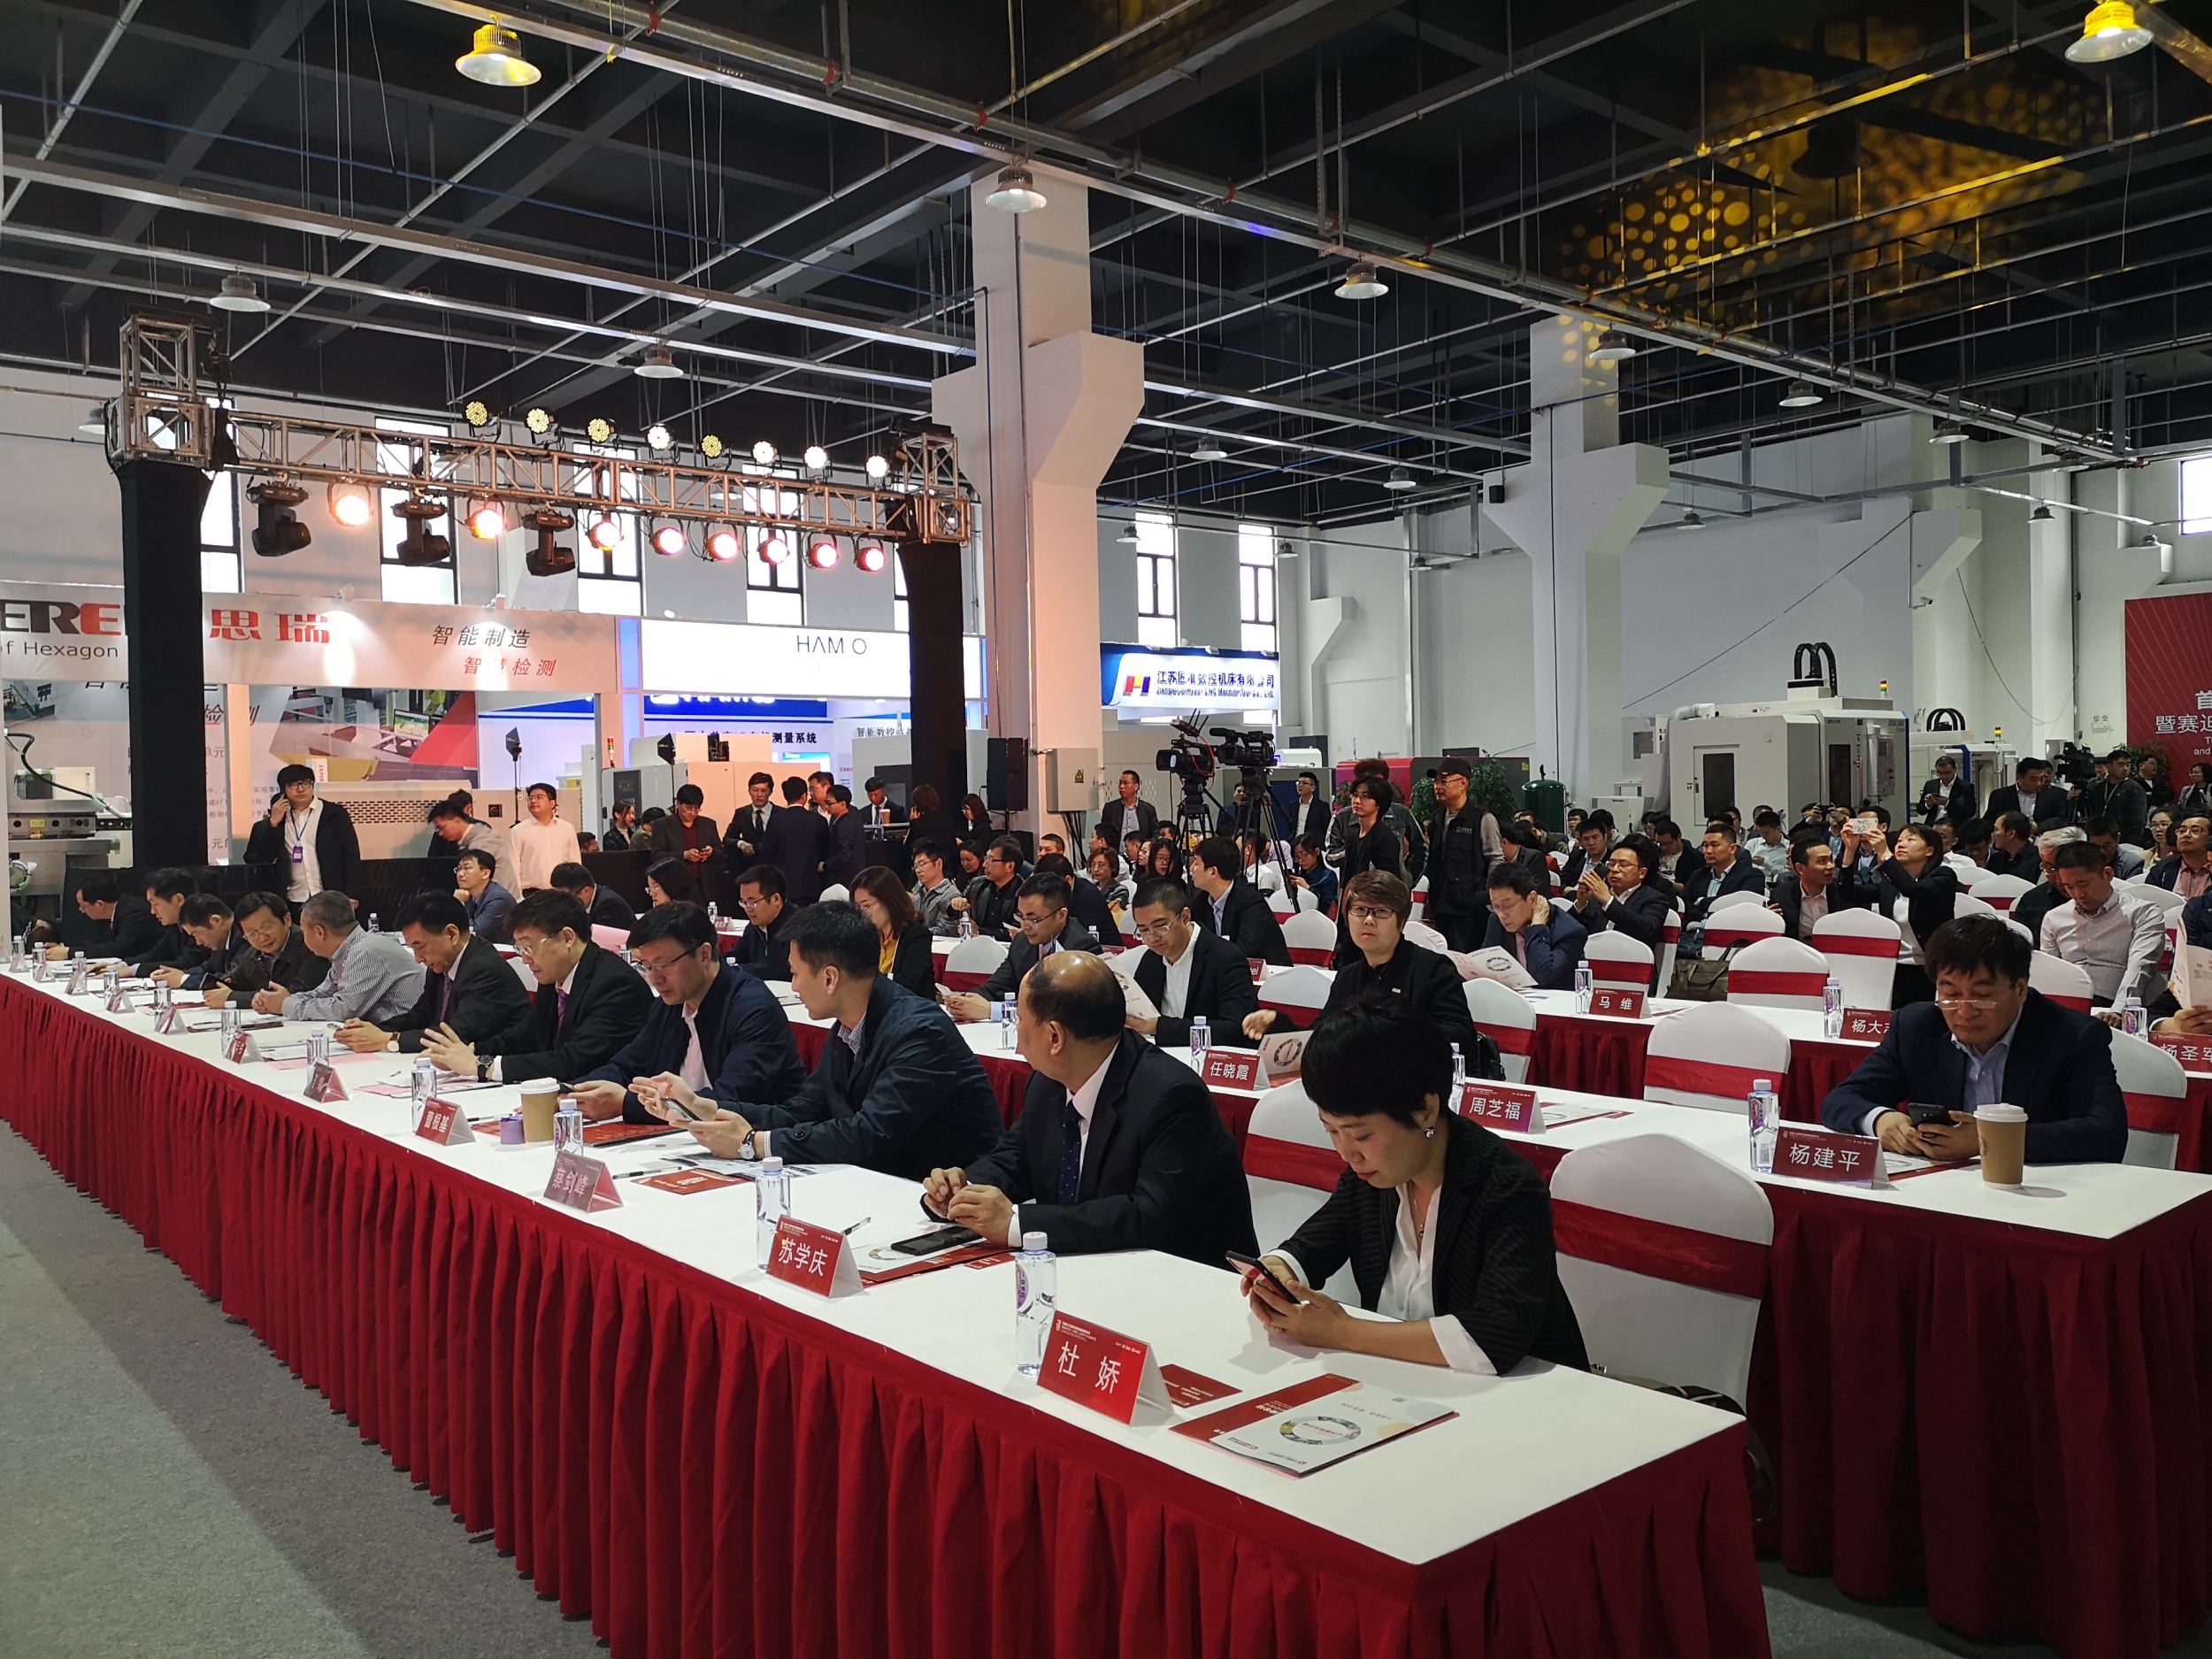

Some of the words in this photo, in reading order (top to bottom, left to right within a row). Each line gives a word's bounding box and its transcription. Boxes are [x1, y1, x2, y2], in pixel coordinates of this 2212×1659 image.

[209, 609, 330, 643] 思瑞
[433, 624, 530, 649] 智能制造
[24, 641, 119, 660] Hexagon
[772, 732, 818, 744] 测量系统
[2193, 747, 2211, 756] and
[1599, 995, 1632, 1010] 马维
[1210, 1061, 1249, 1081] 任晓霞
[1469, 1096, 1522, 1121] 周芝福
[1789, 1142, 1861, 1172] 杨建平
[778, 1237, 828, 1277] 苏学庆
[1058, 1340, 1122, 1394] 杜娇
